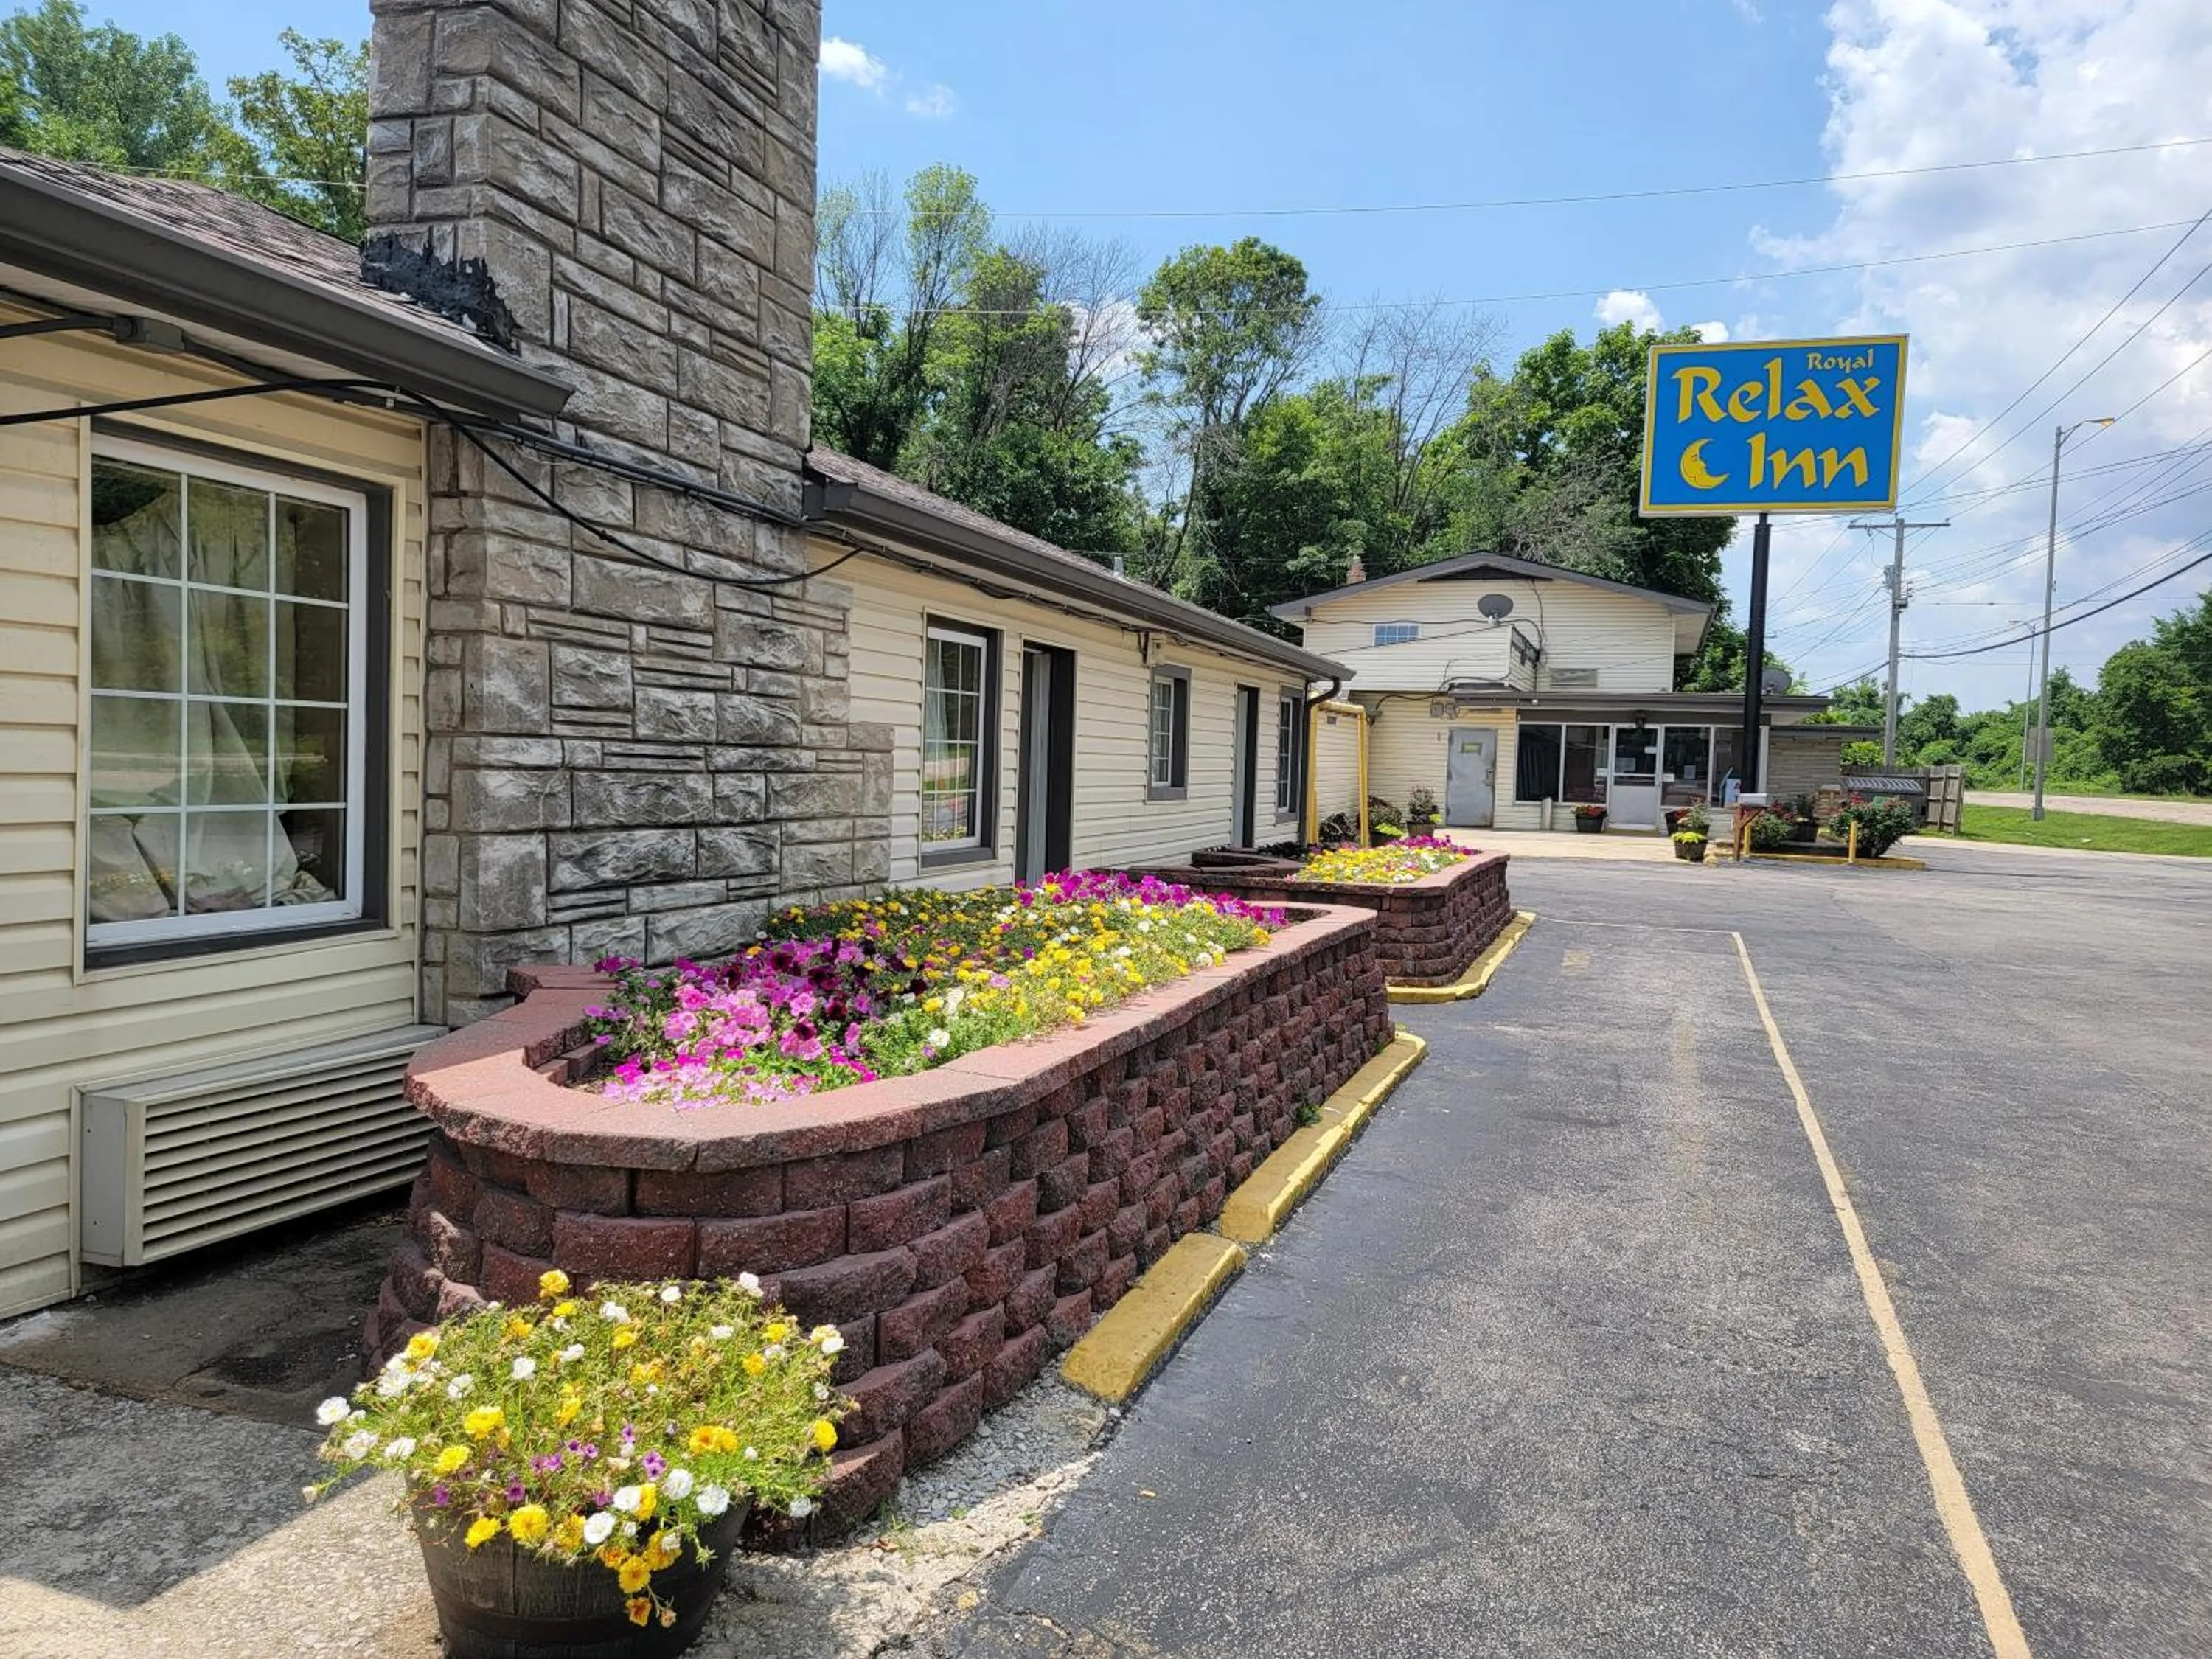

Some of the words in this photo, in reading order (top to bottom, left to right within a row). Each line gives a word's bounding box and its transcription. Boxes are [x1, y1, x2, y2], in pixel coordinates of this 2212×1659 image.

[1670, 357, 1882, 424] Relax
[1806, 349, 1874, 374] Royal
[1747, 431, 1869, 490] Inn
